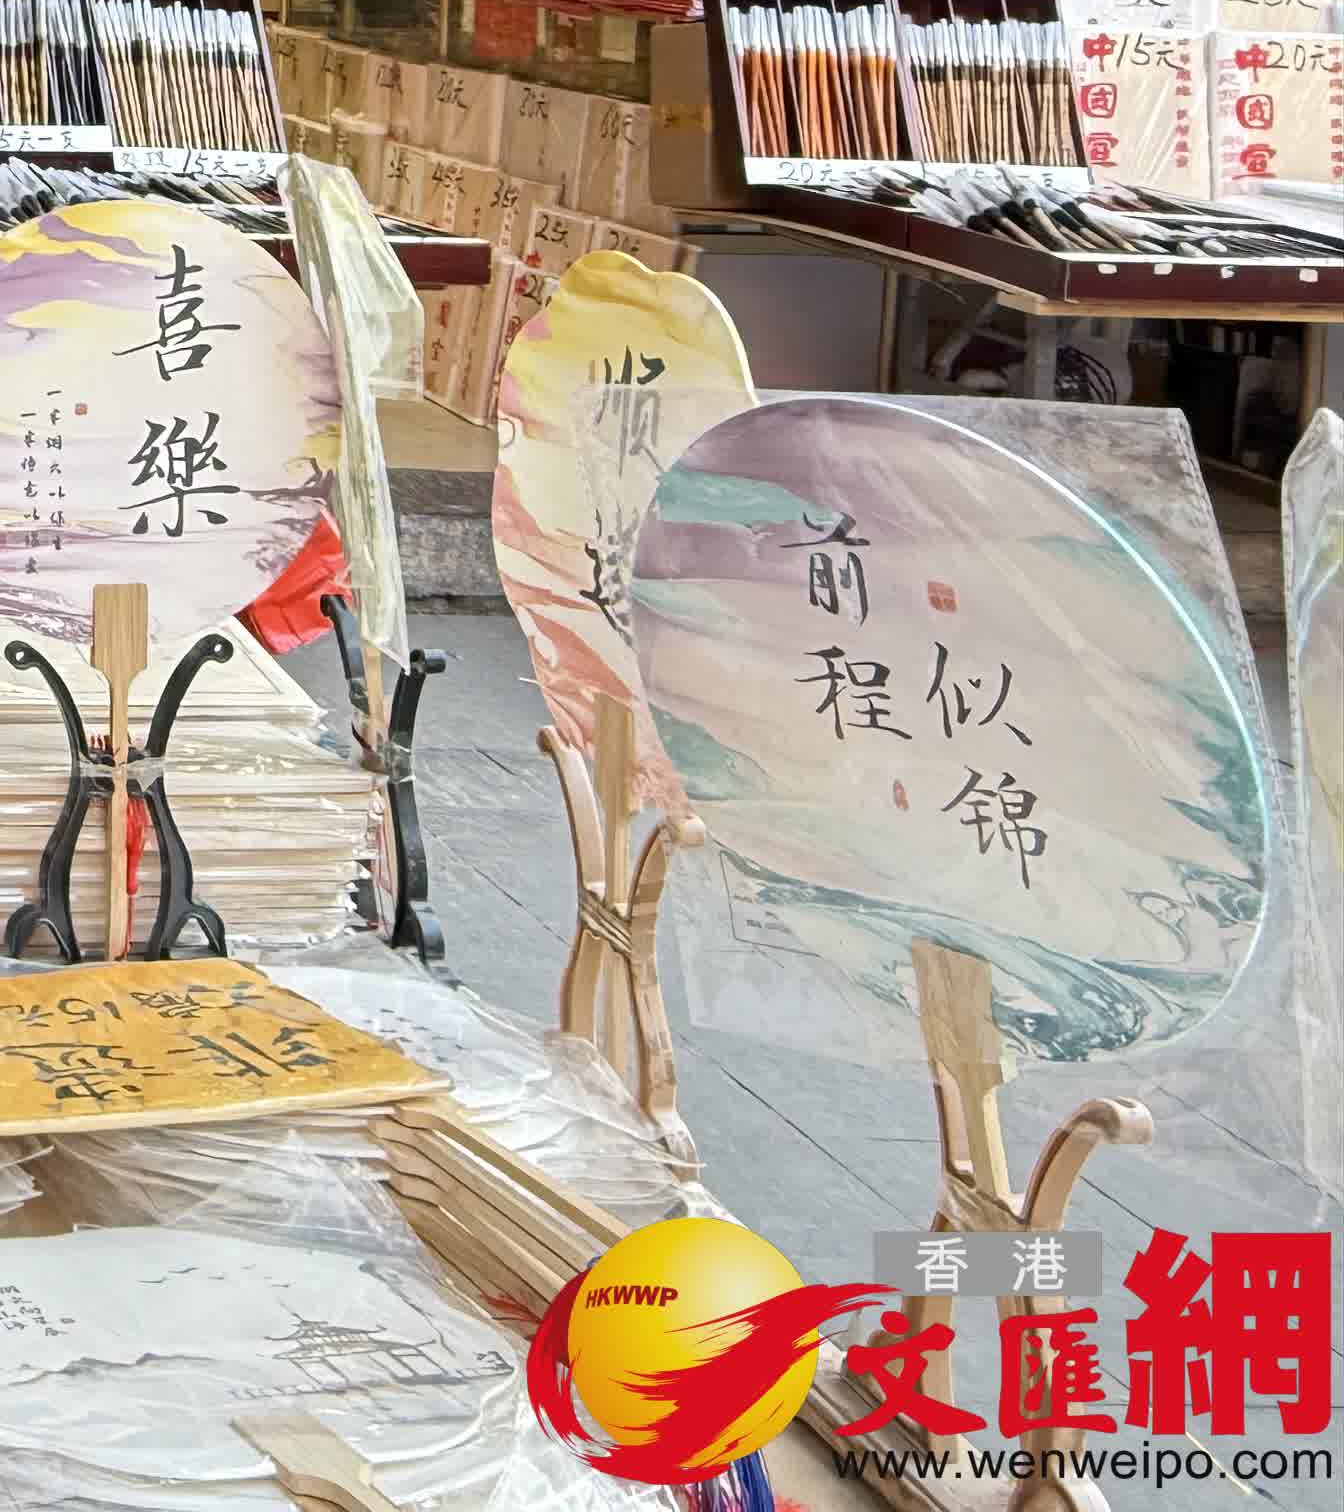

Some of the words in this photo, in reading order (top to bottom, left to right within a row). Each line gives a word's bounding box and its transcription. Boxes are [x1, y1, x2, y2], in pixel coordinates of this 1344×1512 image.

[1115, 32, 1185, 70] 15元
[1265, 40, 1334, 72] 20元
[112, 243, 242, 538] 喜樂
[779, 510, 913, 741] 前程
[925, 640, 1050, 891] 似锦
